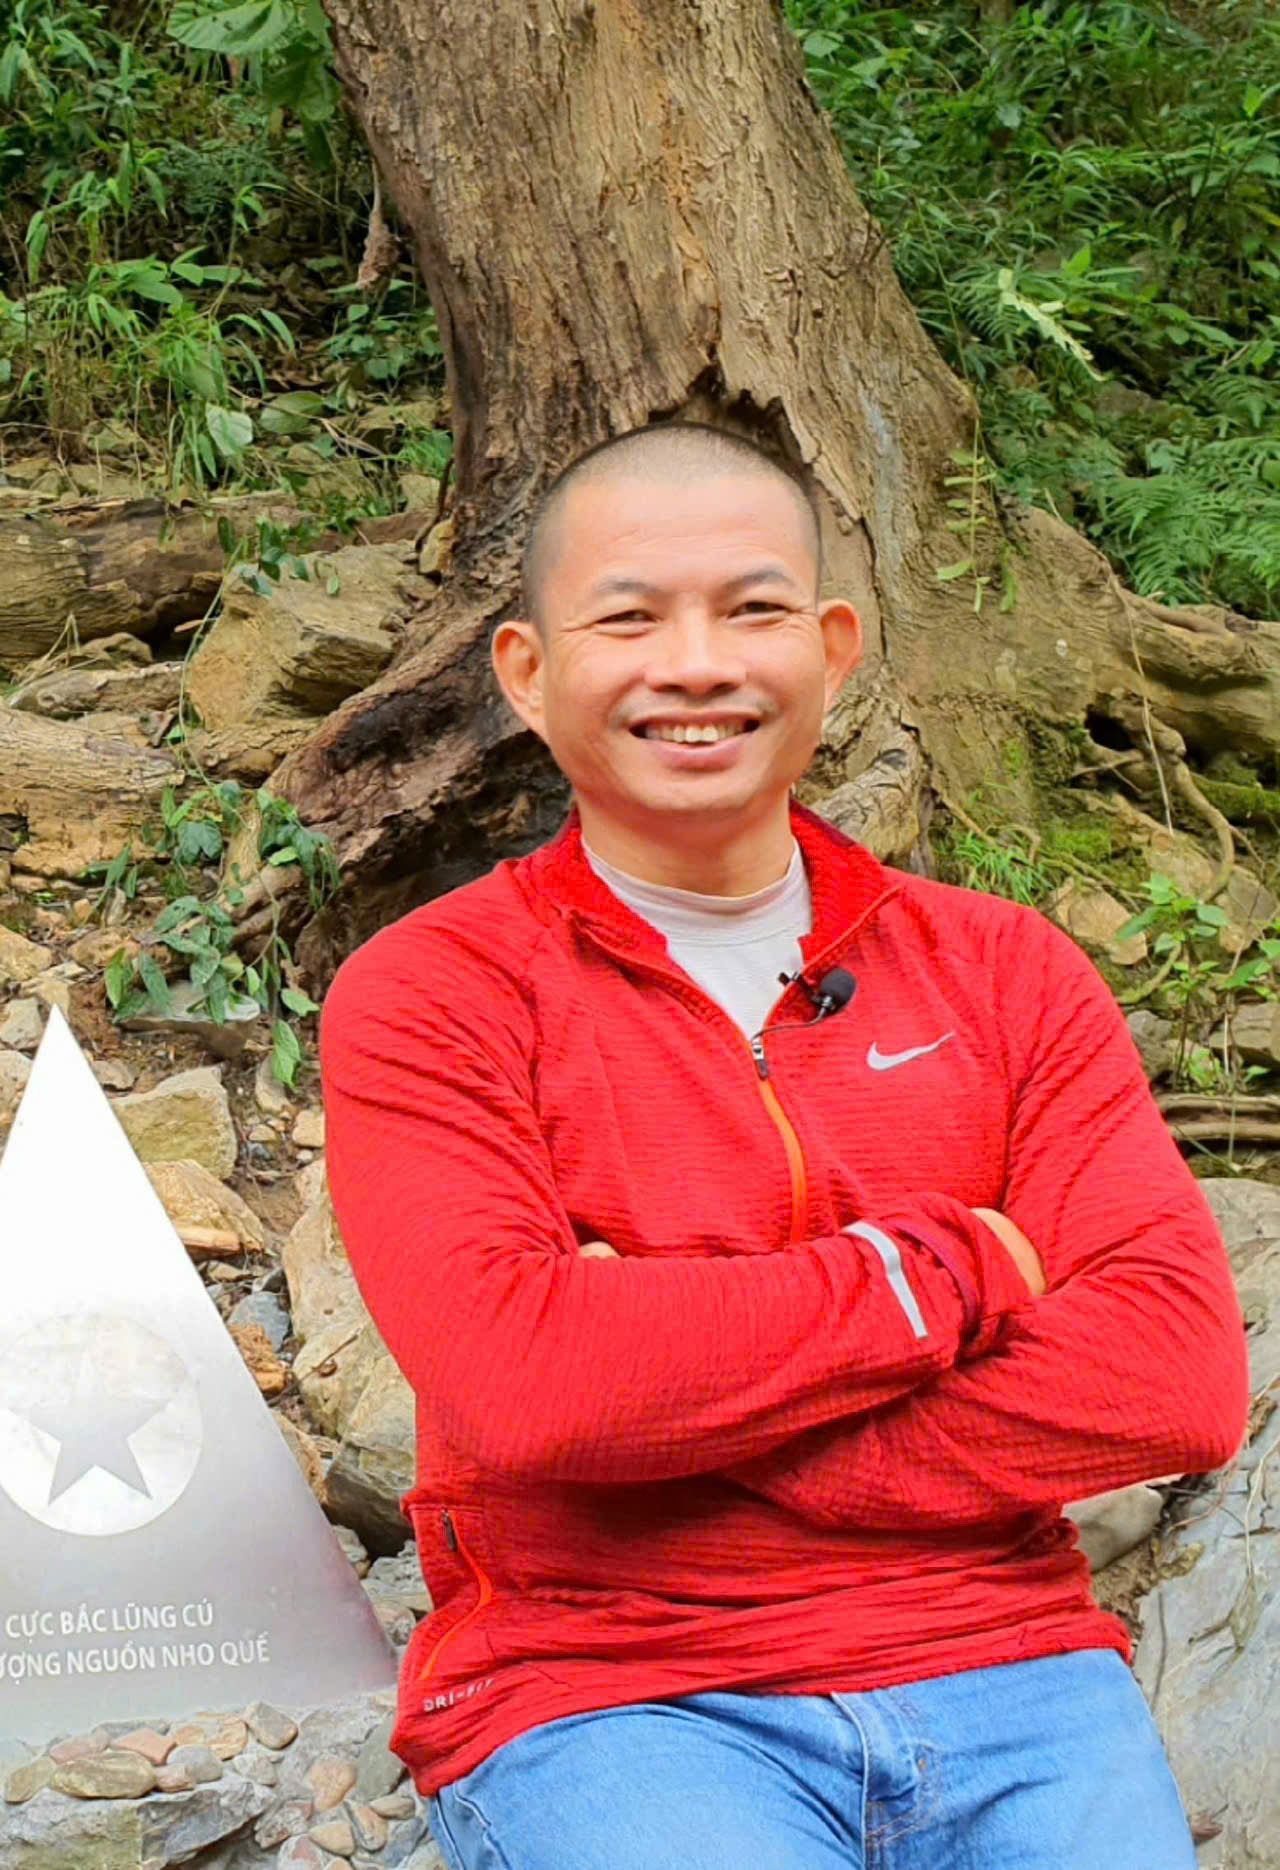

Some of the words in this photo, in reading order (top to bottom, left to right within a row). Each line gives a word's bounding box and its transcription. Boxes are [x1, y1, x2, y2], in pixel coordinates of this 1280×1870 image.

[5, 1610, 55, 1644] CỰC
[111, 1602, 177, 1631] LŨNG
[182, 1597, 214, 1627] CÚ
[161, 1642, 215, 1668] NHO
[220, 1631, 270, 1666] QUẾ
